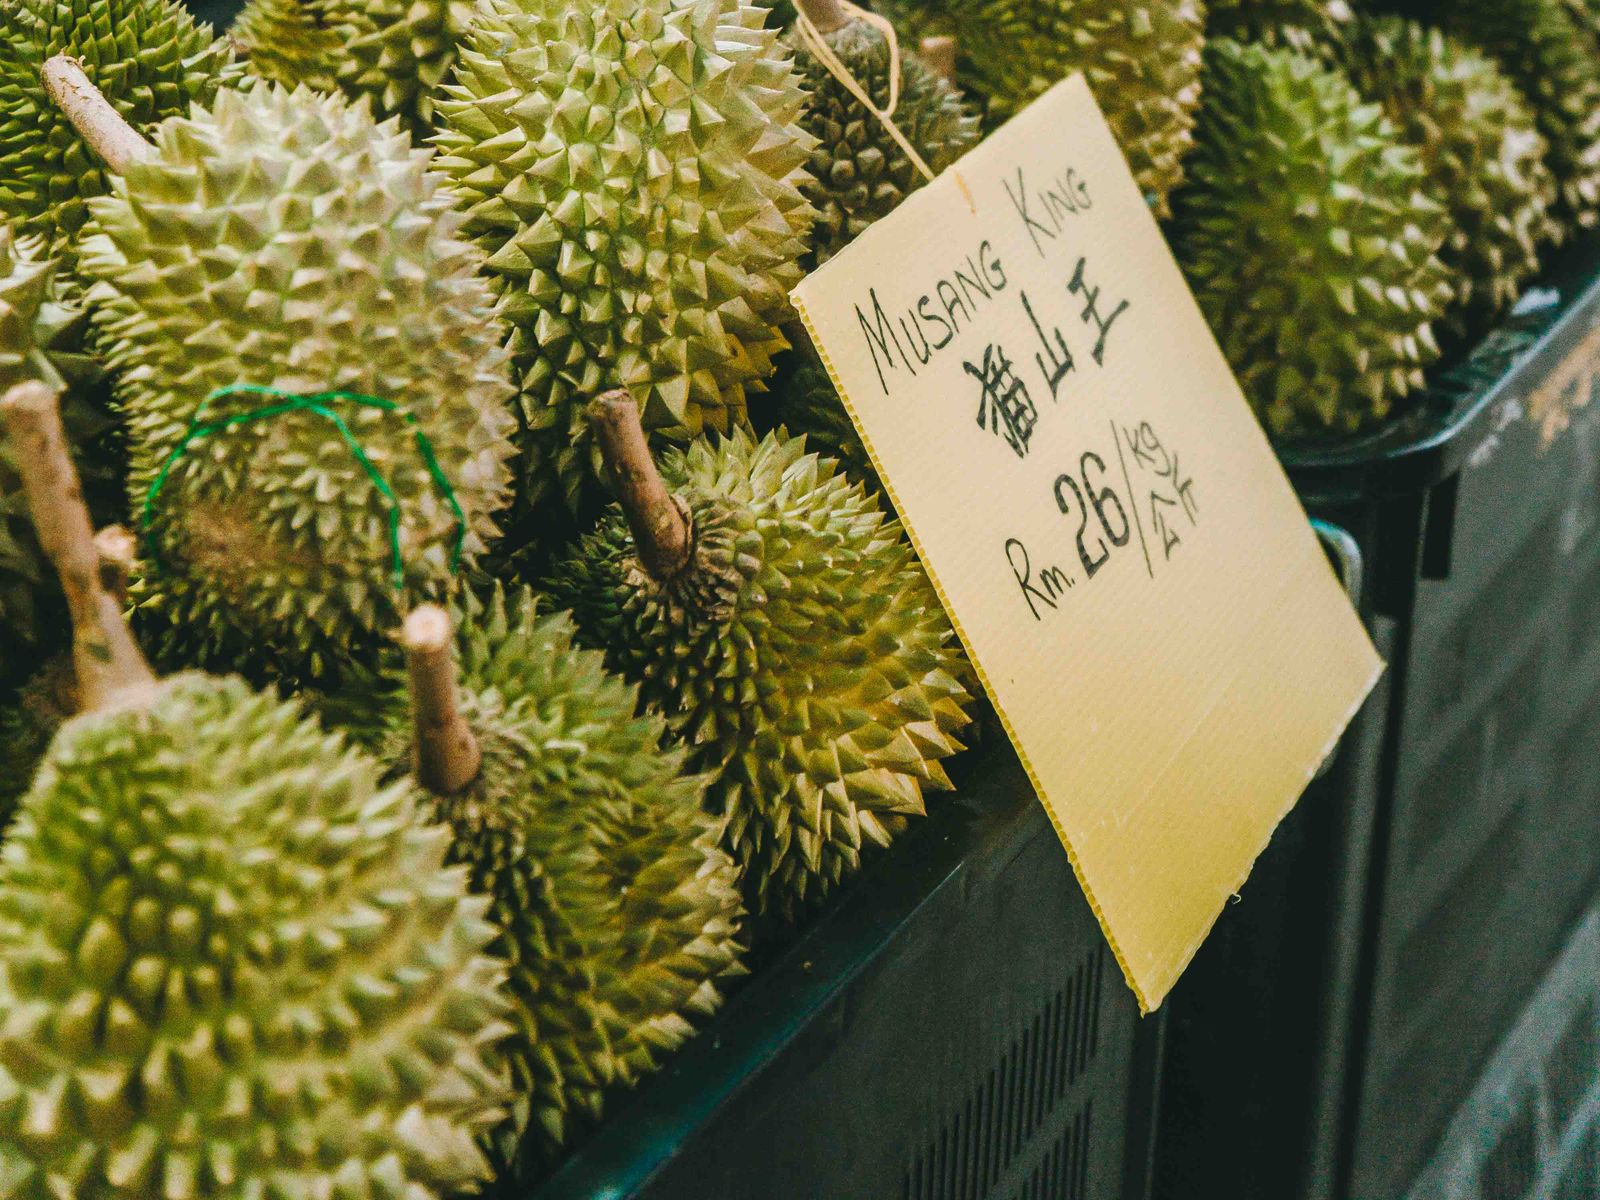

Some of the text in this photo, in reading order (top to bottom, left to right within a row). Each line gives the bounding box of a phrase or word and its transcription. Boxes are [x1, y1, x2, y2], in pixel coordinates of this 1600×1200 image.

[854, 166, 1092, 396] MUSANG KING
[962, 256, 1131, 460] 猫山王
